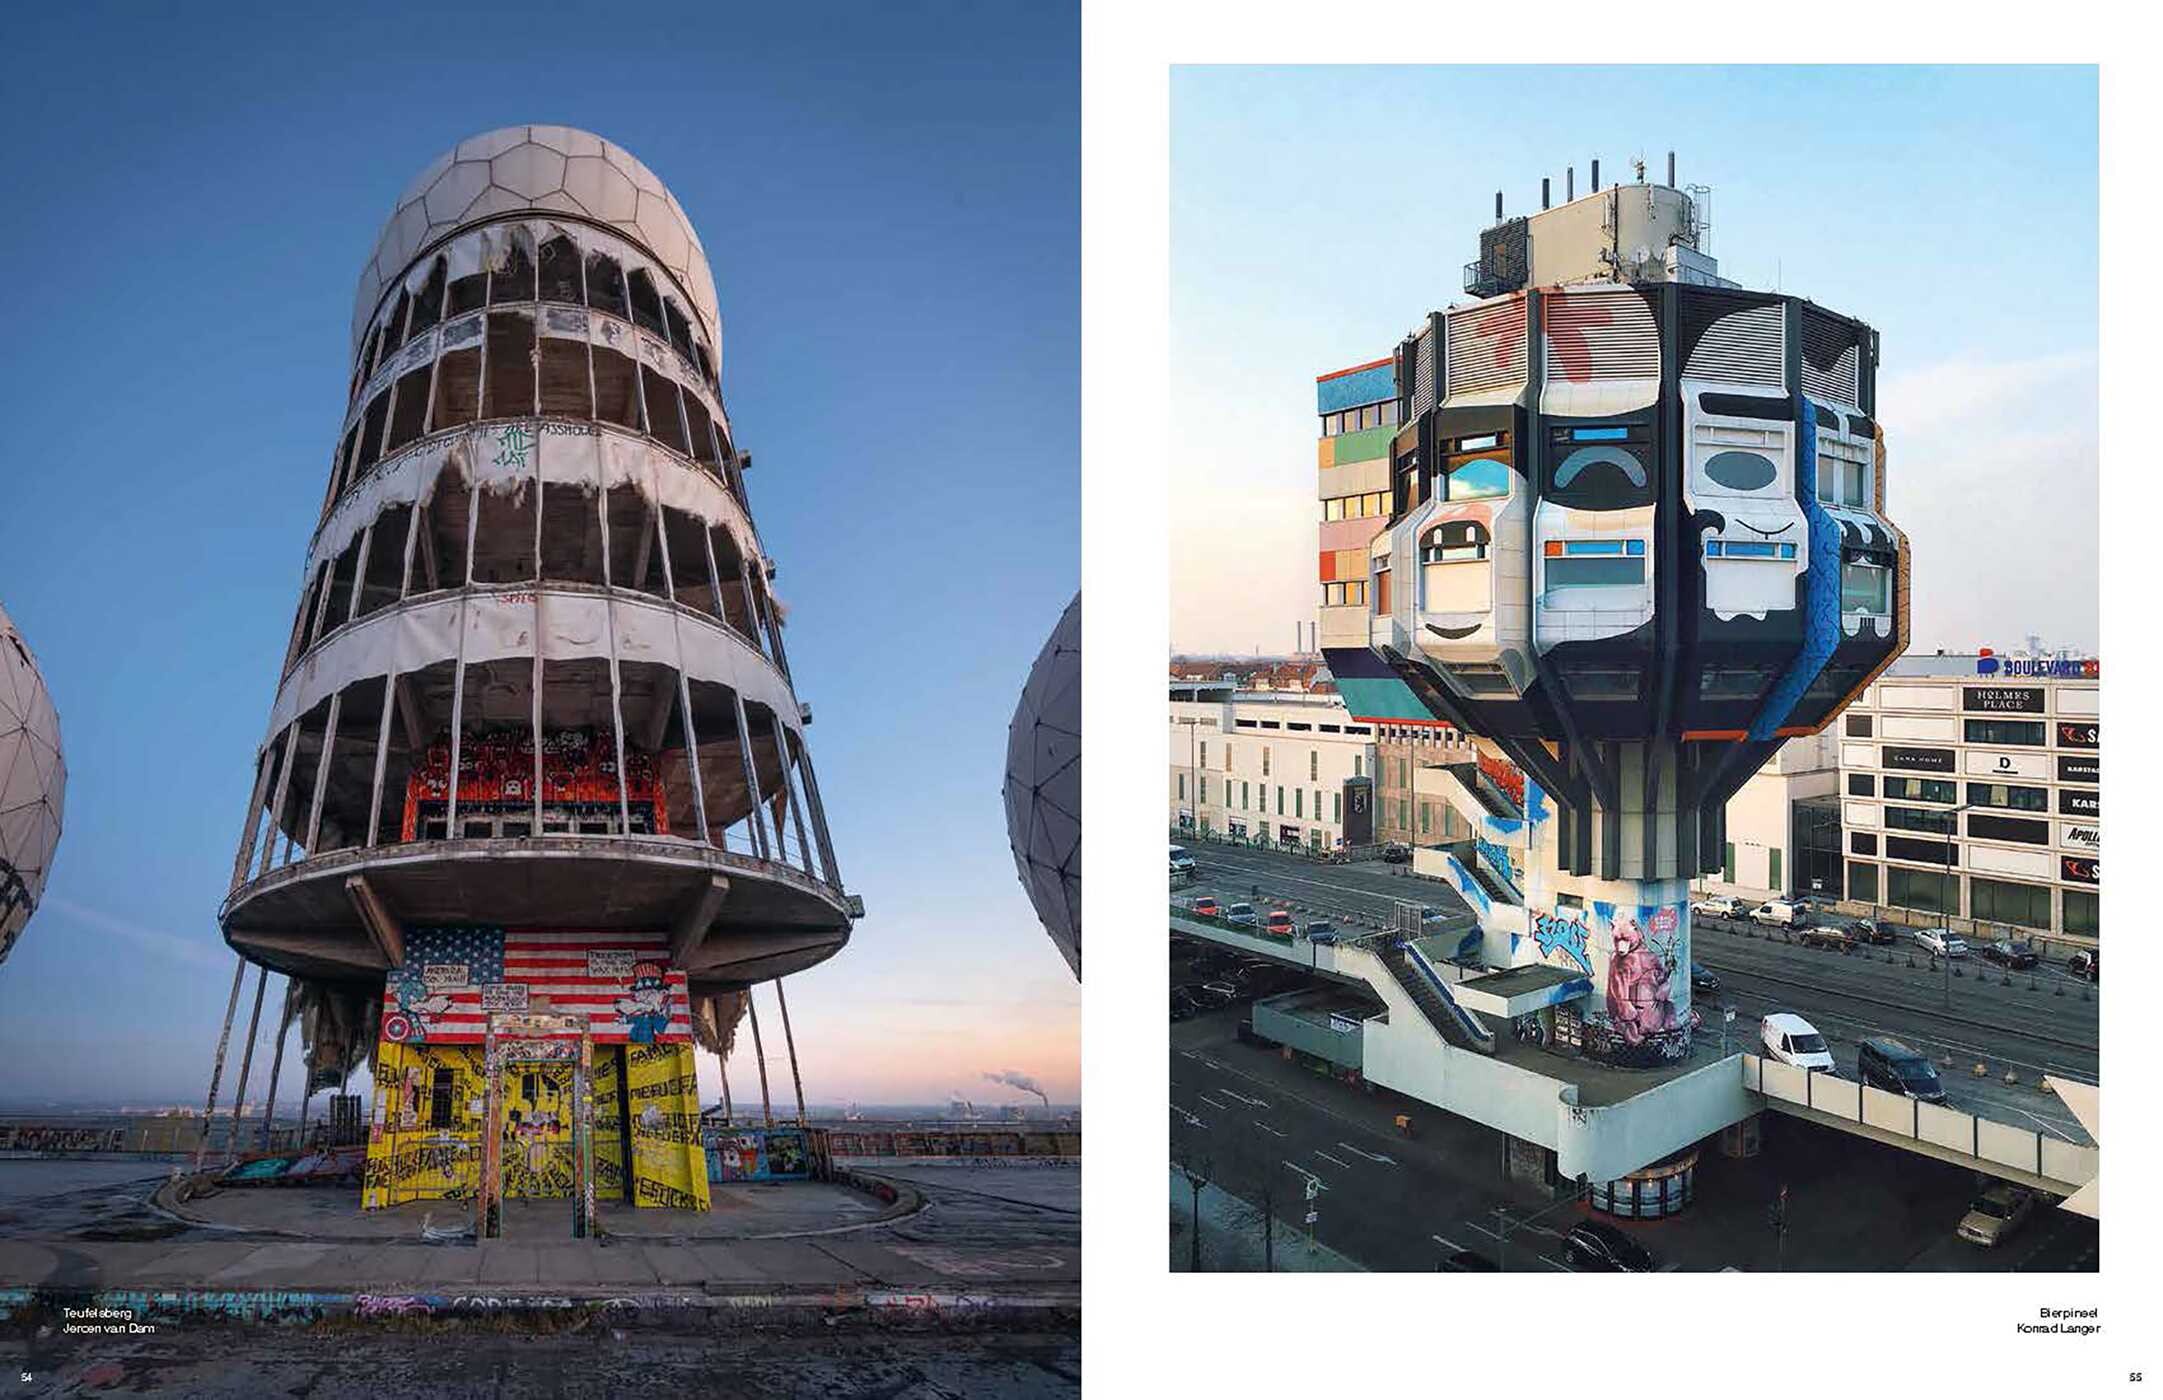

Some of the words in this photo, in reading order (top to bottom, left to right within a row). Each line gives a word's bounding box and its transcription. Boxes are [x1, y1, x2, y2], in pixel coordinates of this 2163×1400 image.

[2003, 660, 2080, 677] BOULEVARD
[1977, 690, 2031, 701] HOLMES
[1983, 700, 2024, 710] PLACE
